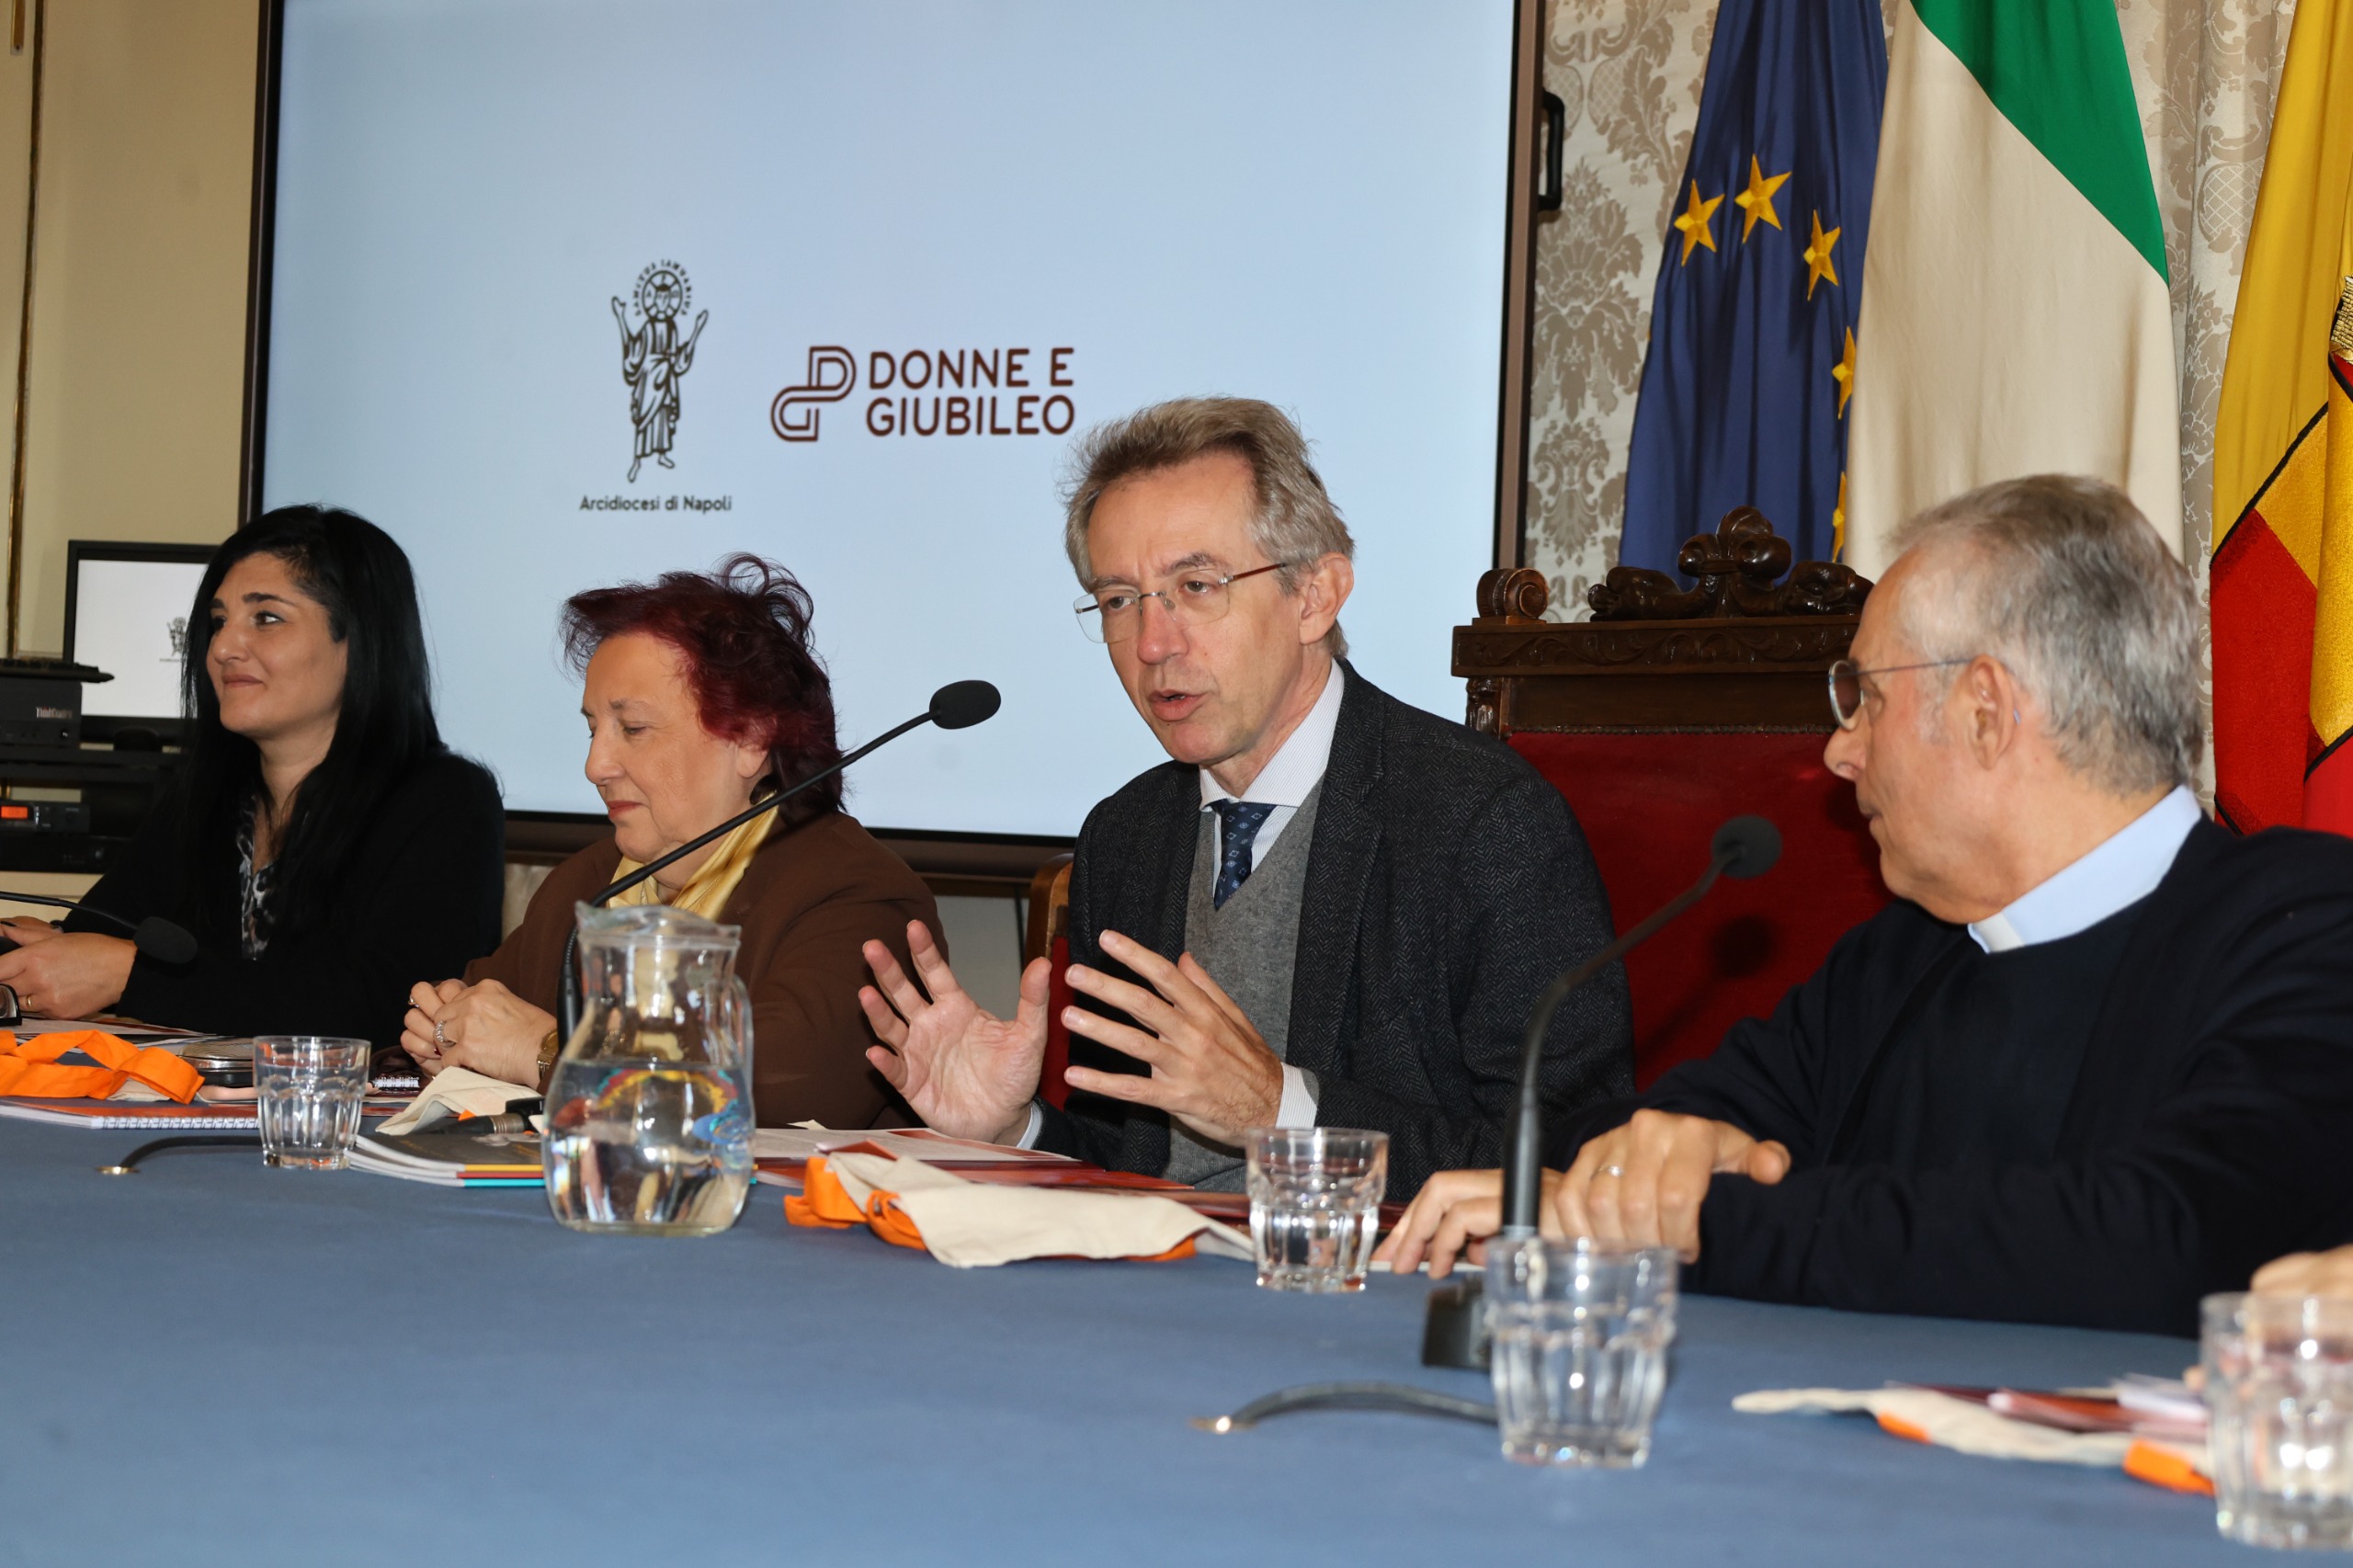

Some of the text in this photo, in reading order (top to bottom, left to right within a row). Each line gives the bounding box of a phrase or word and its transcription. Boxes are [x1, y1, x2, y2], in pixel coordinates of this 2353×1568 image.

[869, 347, 1074, 391] DONNE E
[866, 394, 1075, 437] GIUBILEO
[579, 495, 732, 515] Arcidiocesi di Napoli
